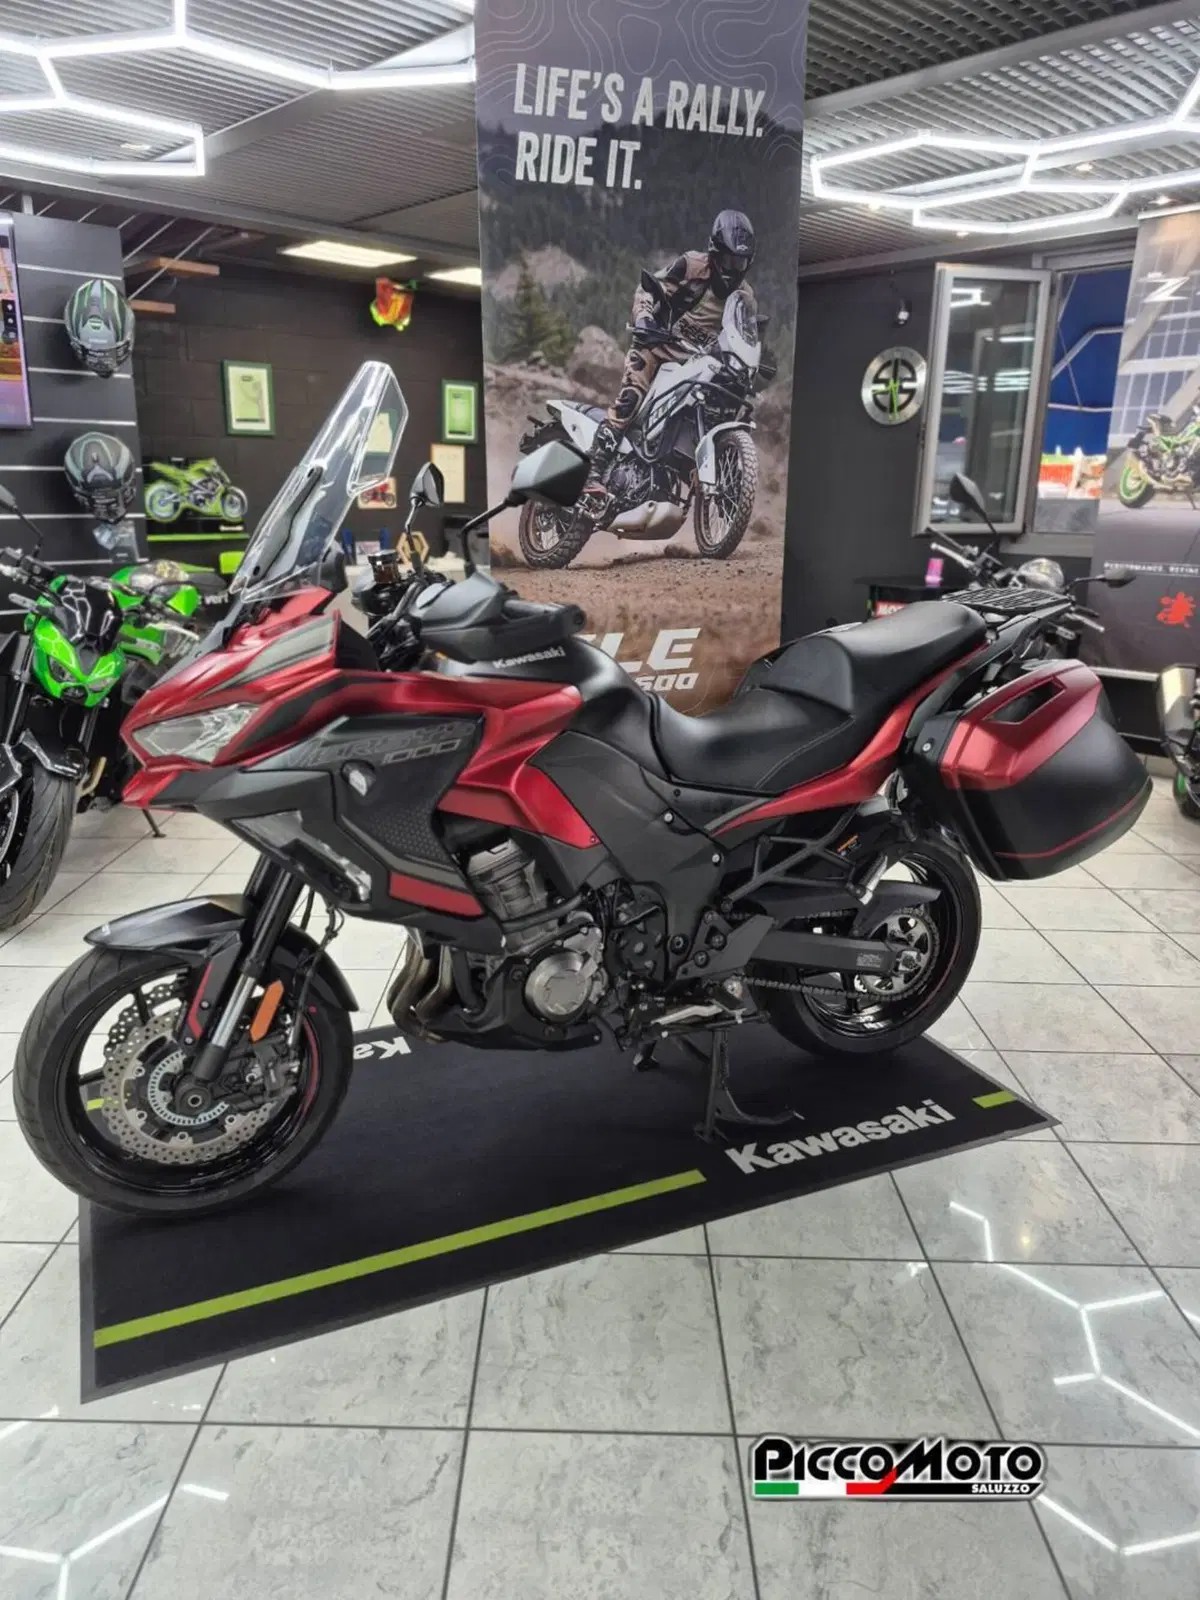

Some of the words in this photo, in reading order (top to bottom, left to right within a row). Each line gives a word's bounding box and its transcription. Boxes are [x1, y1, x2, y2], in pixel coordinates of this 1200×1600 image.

[514, 62, 625, 124] LIFE'S
[631, 76, 654, 127] A
[665, 79, 766, 138] RALLY.
[515, 130, 598, 186] RIDE
[606, 138, 642, 190] IT.
[492, 645, 566, 669] Kawasaki
[633, 672, 700, 692] 500
[380, 738, 461, 765] 1000
[724, 1099, 956, 1174] Kawasaki
